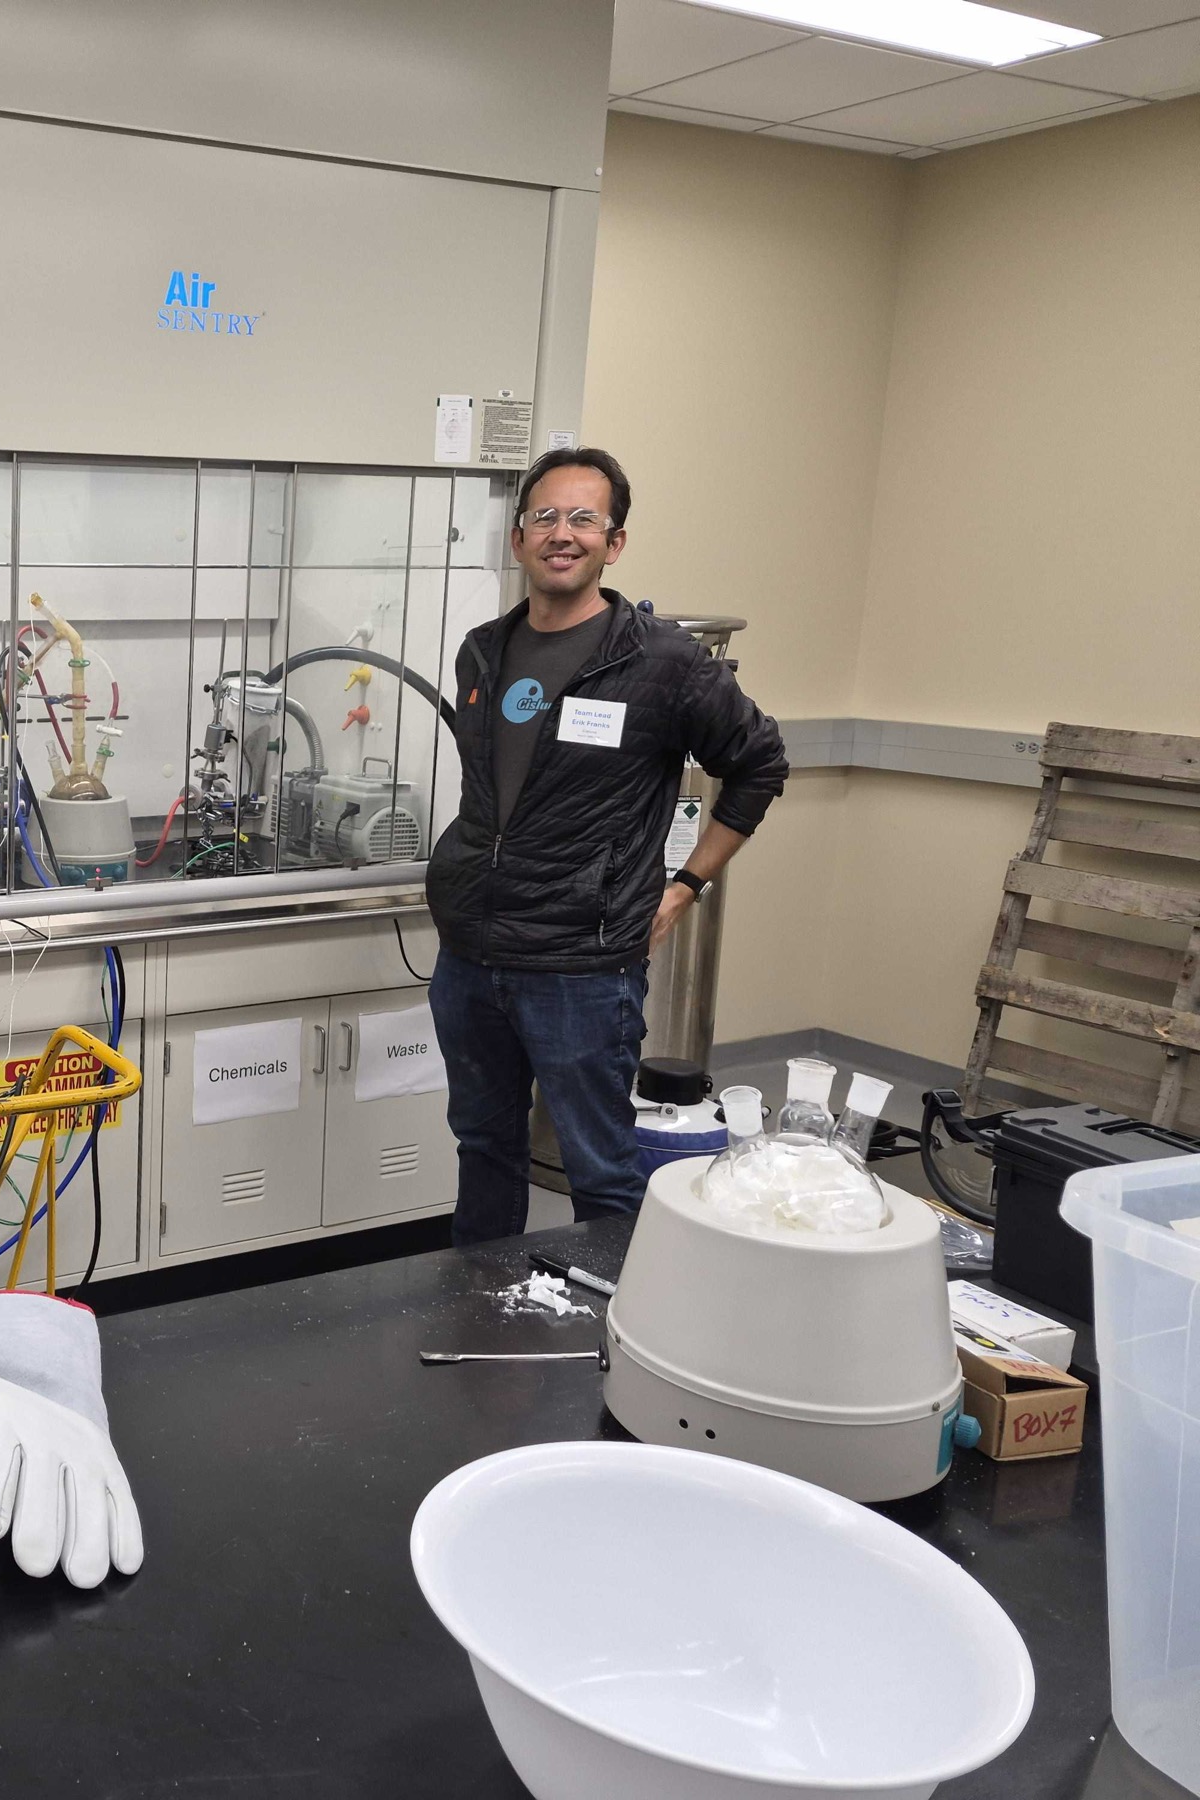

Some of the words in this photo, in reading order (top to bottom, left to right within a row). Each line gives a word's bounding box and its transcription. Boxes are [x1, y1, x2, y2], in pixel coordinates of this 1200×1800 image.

[165, 271, 216, 308] Air
[157, 308, 260, 336] SENTRY
[575, 709, 593, 717] Team
[594, 711, 612, 719] Lead
[386, 1042, 428, 1059] Waste
[14, 1055, 94, 1078] CATION
[209, 1059, 288, 1083] Chemicals
[86, 1102, 118, 1126] AAY
